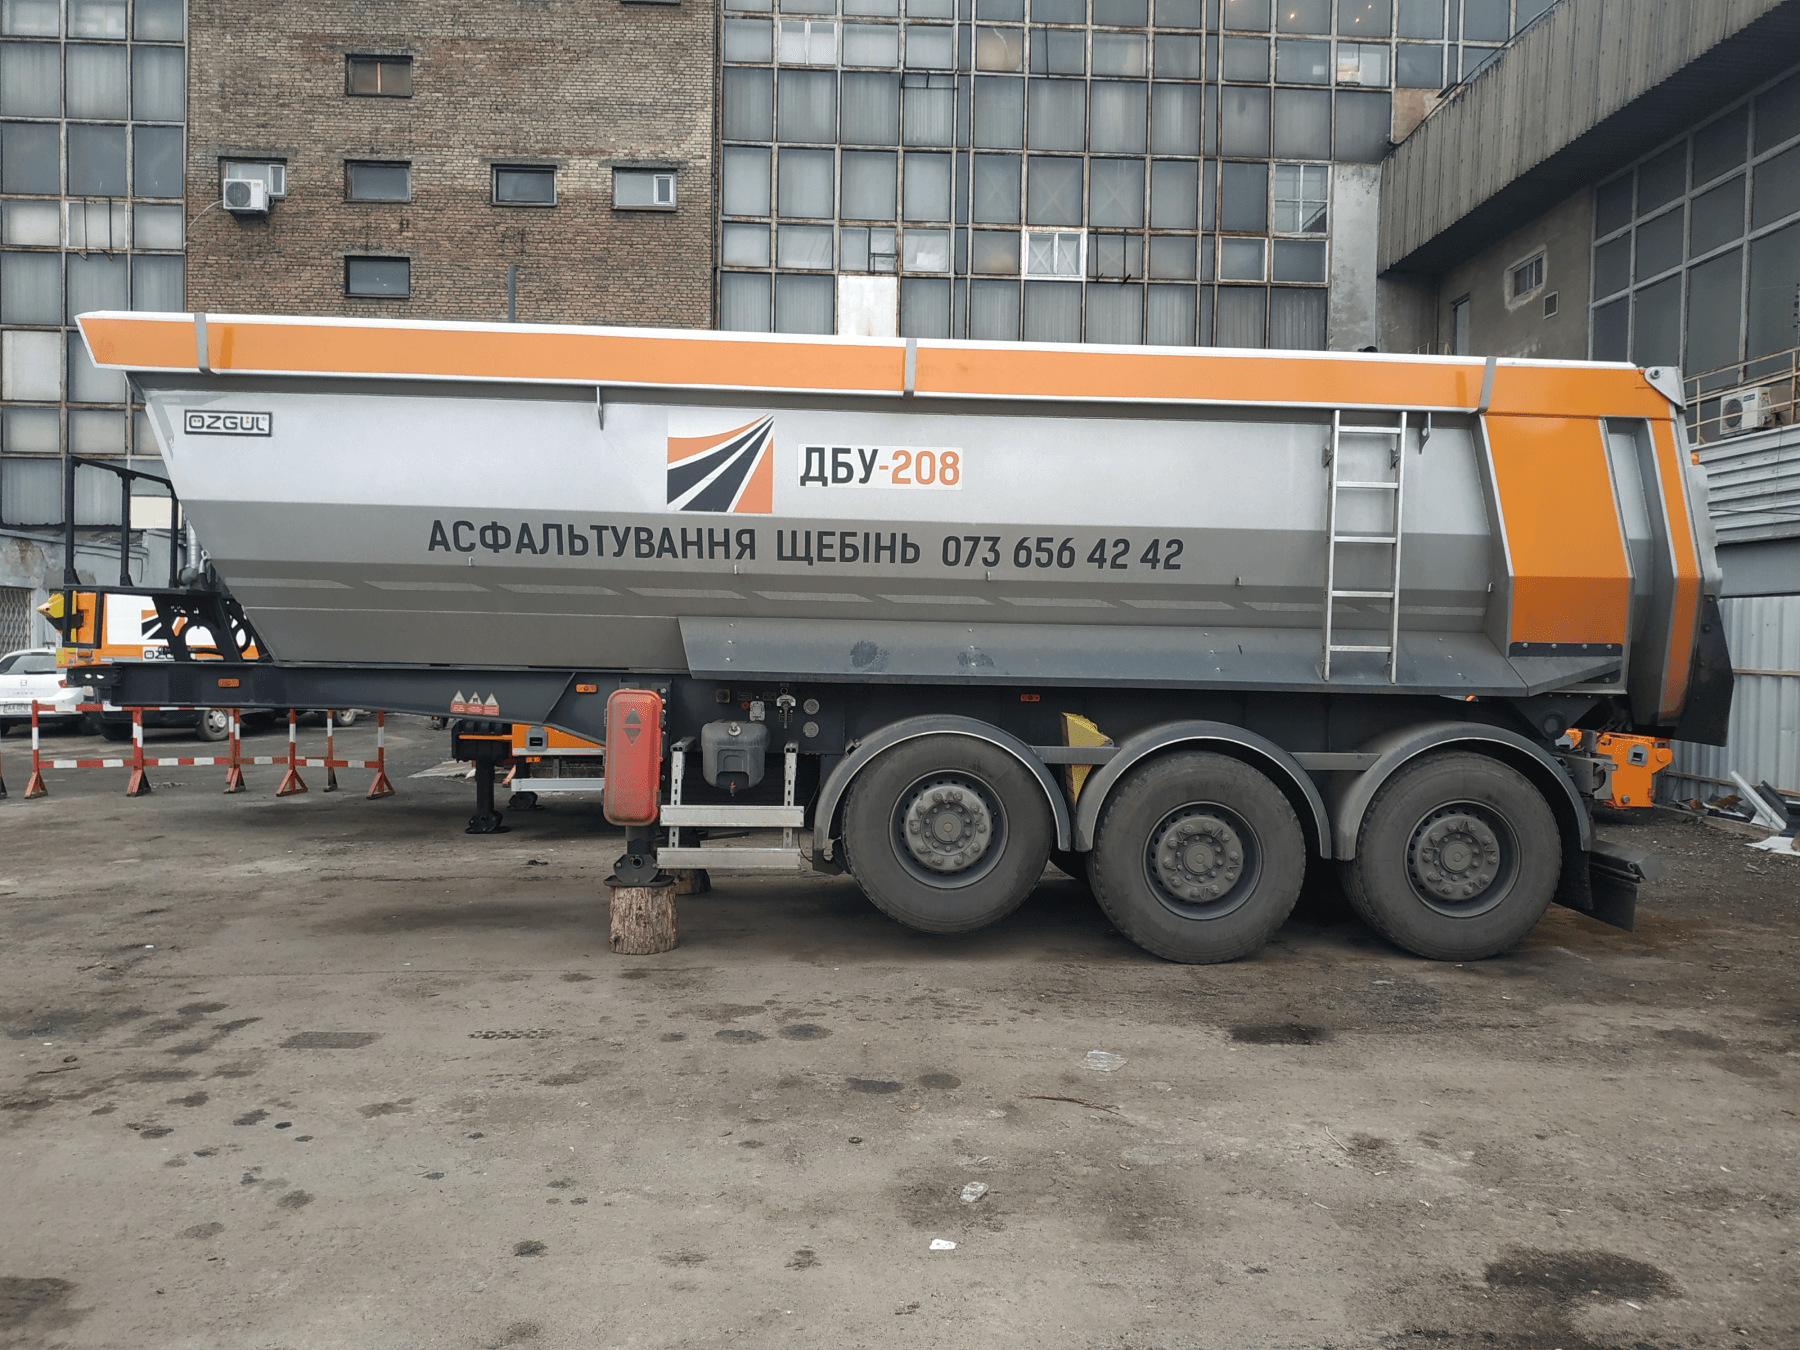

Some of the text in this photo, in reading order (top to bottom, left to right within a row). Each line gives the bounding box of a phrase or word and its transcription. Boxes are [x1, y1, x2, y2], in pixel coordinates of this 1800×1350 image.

[188, 414, 267, 432] ÖZGÜL
[799, 446, 960, 487] ДБУ-208
[428, 519, 1184, 571] АСФАЛЬТУВАННЯ ЩЕБІНЬ 073 656 42 42
